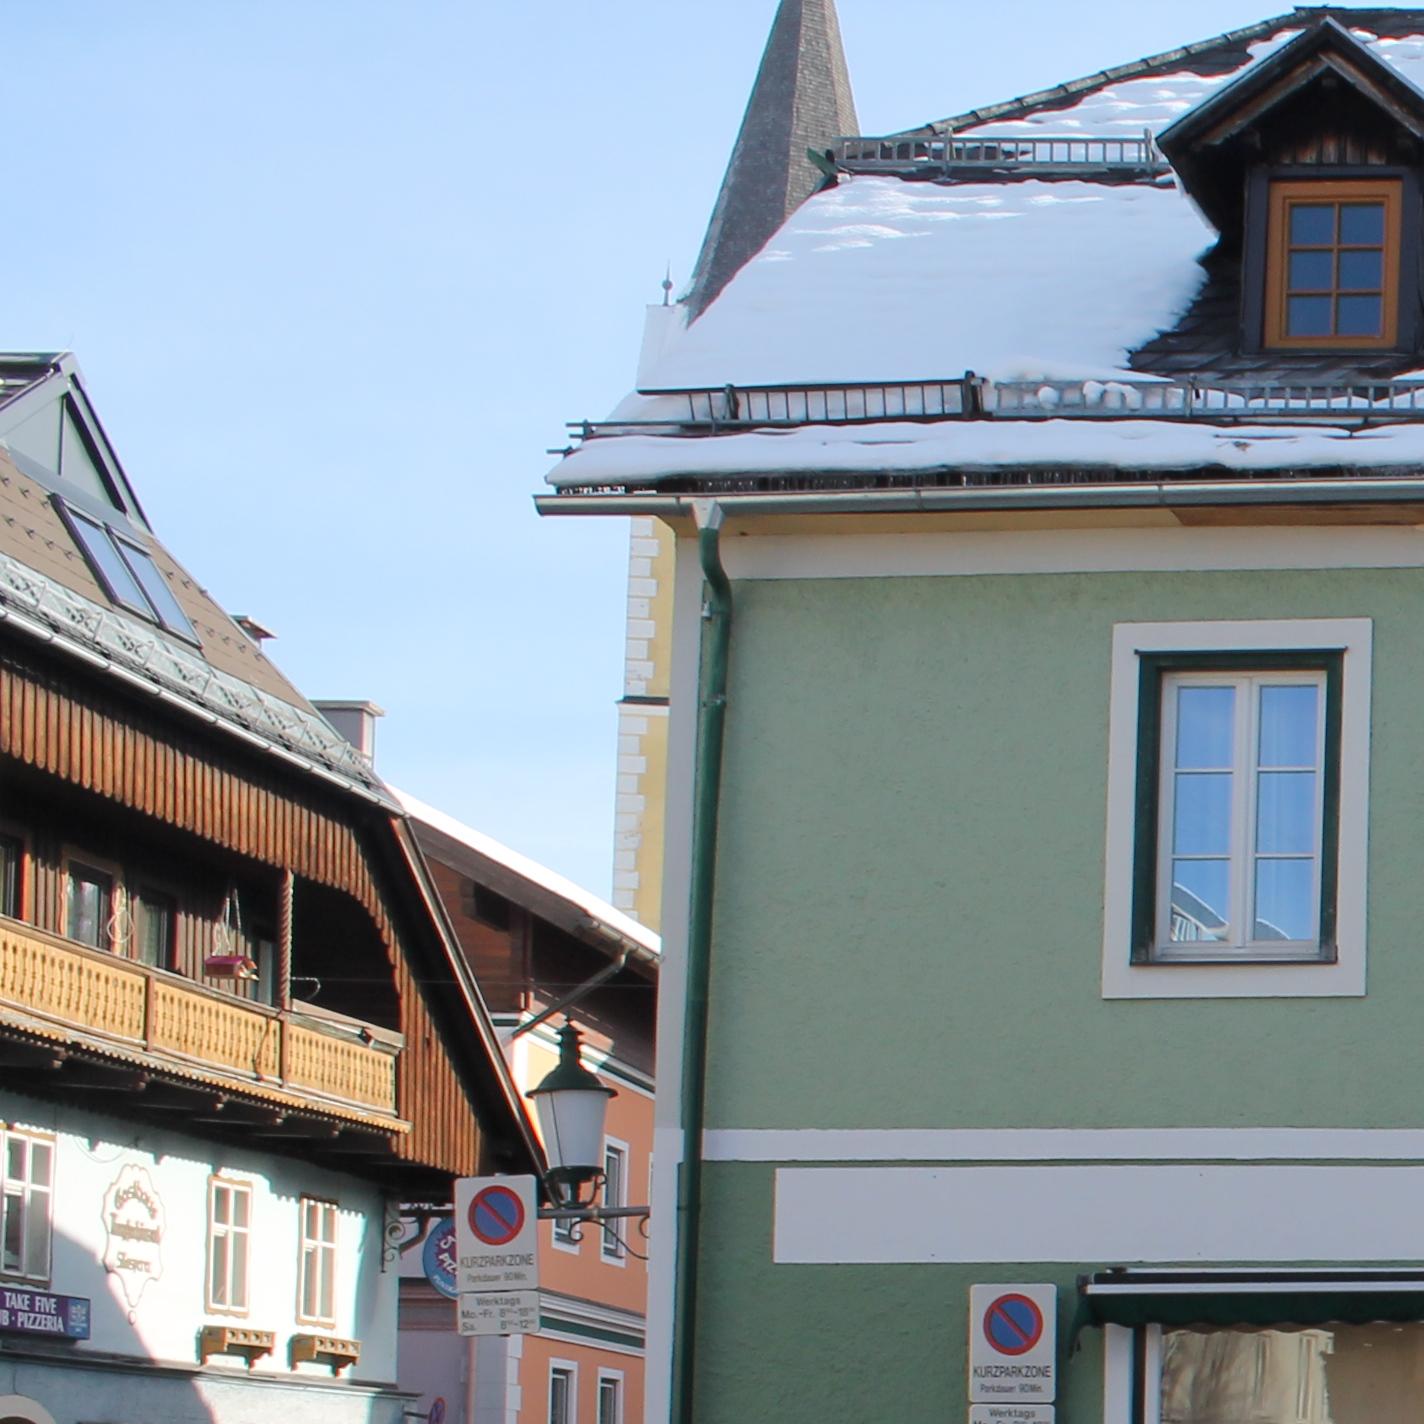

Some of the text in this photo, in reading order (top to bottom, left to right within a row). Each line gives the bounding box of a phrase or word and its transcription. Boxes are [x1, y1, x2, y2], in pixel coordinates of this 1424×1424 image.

[461, 1254, 535, 1268] KURZPARKZONE
[4, 1292, 57, 1314] TAKE FIVE
[477, 1298, 521, 1307] Werktags
[17, 1312, 64, 1333] PIZZERIA
[974, 1366, 1052, 1378] KURZPARKZONE
[988, 1408, 1036, 1419] Werktags
